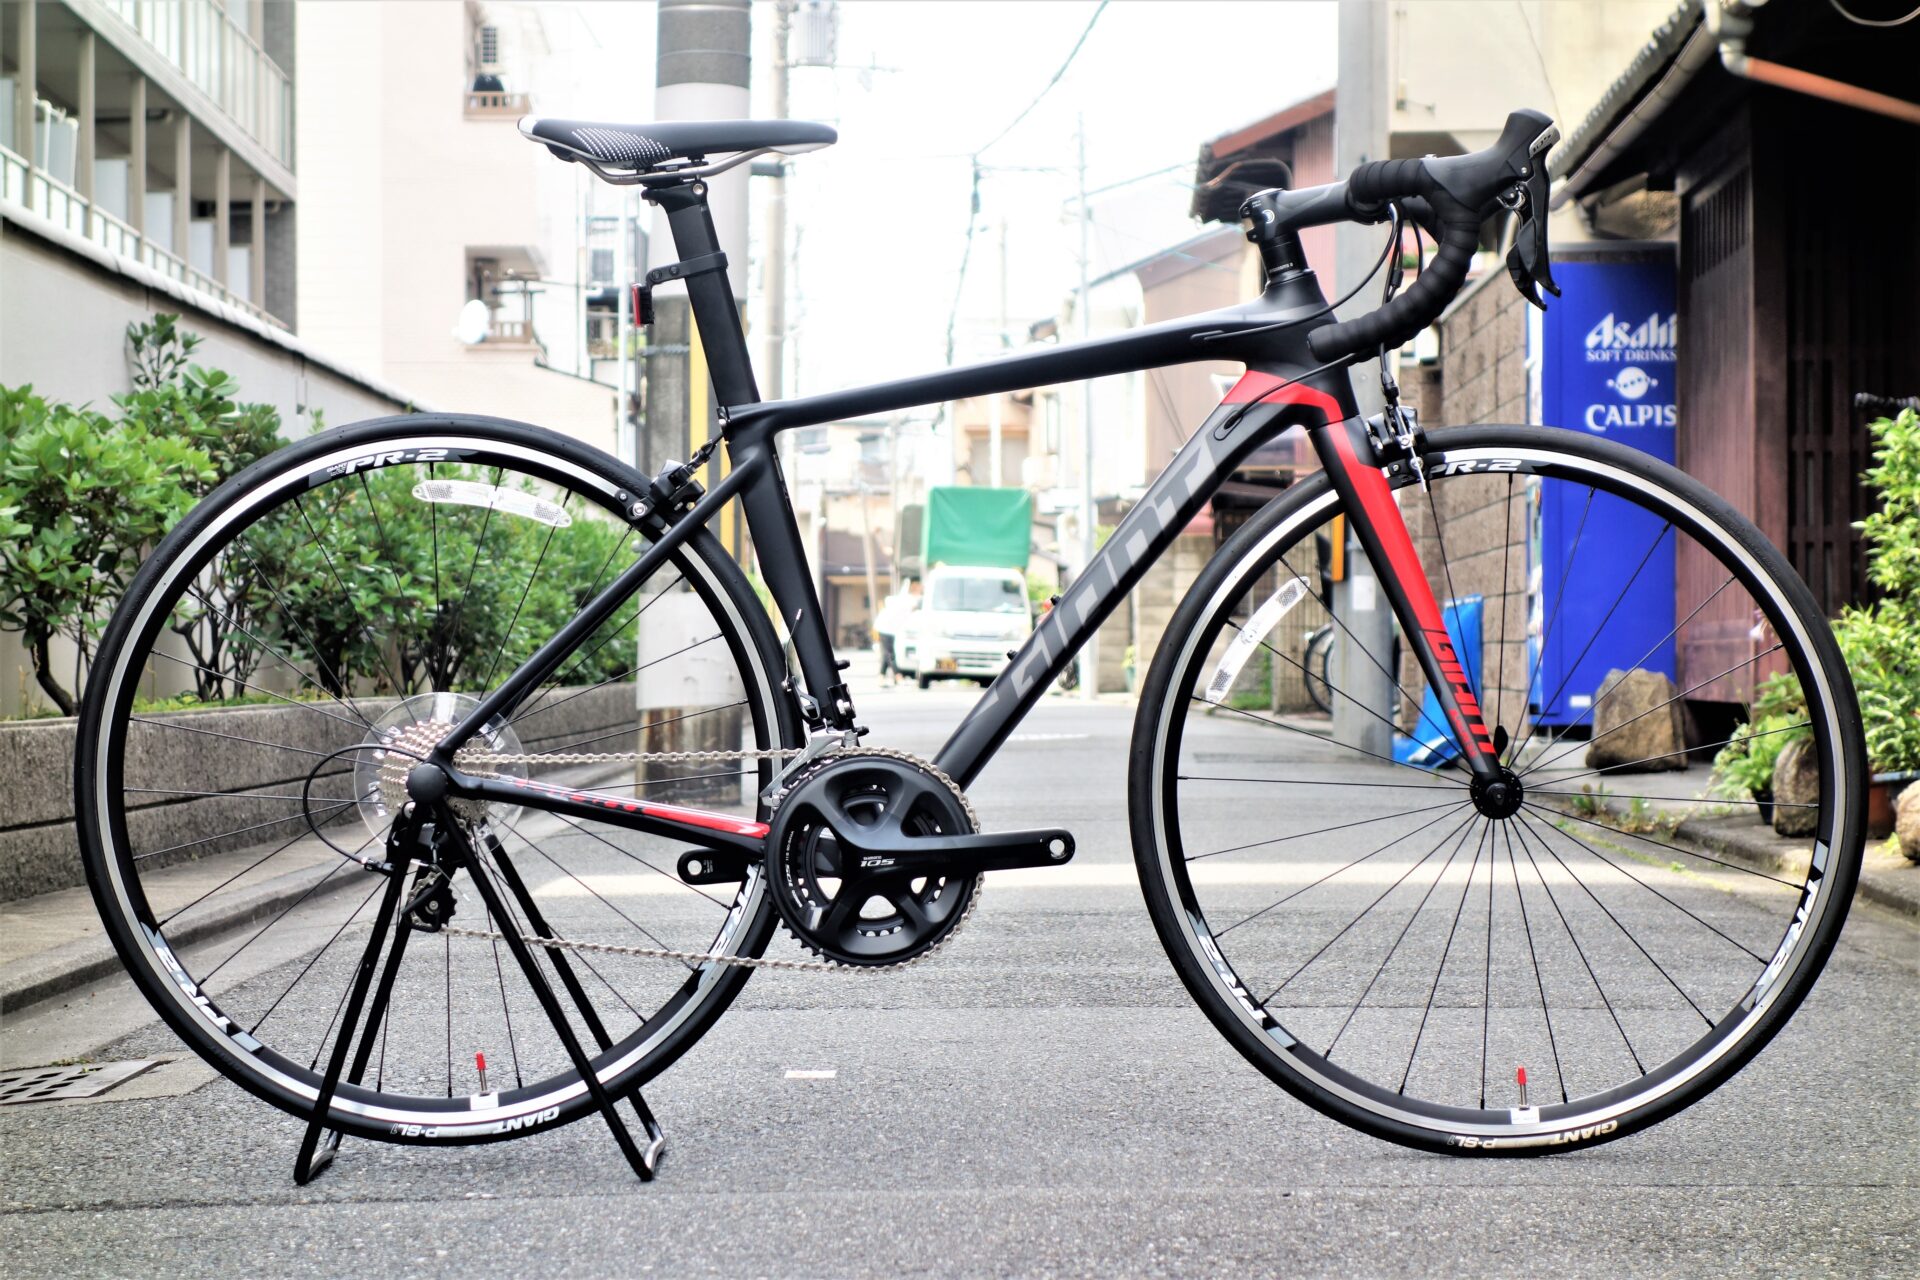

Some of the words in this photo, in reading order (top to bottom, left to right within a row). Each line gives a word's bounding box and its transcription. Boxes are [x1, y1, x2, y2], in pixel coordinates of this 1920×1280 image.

[1585, 312, 1677, 349] Asahi
[1586, 349, 1622, 361] SOFT
[1624, 349, 1677, 361] DRINKS
[1585, 403, 1677, 432] CALPIS
[346, 449, 448, 474] PR-2
[860, 858, 896, 868] 105
[494, 1106, 560, 1134] GIANT
[1554, 1119, 1618, 1144] GIANT
